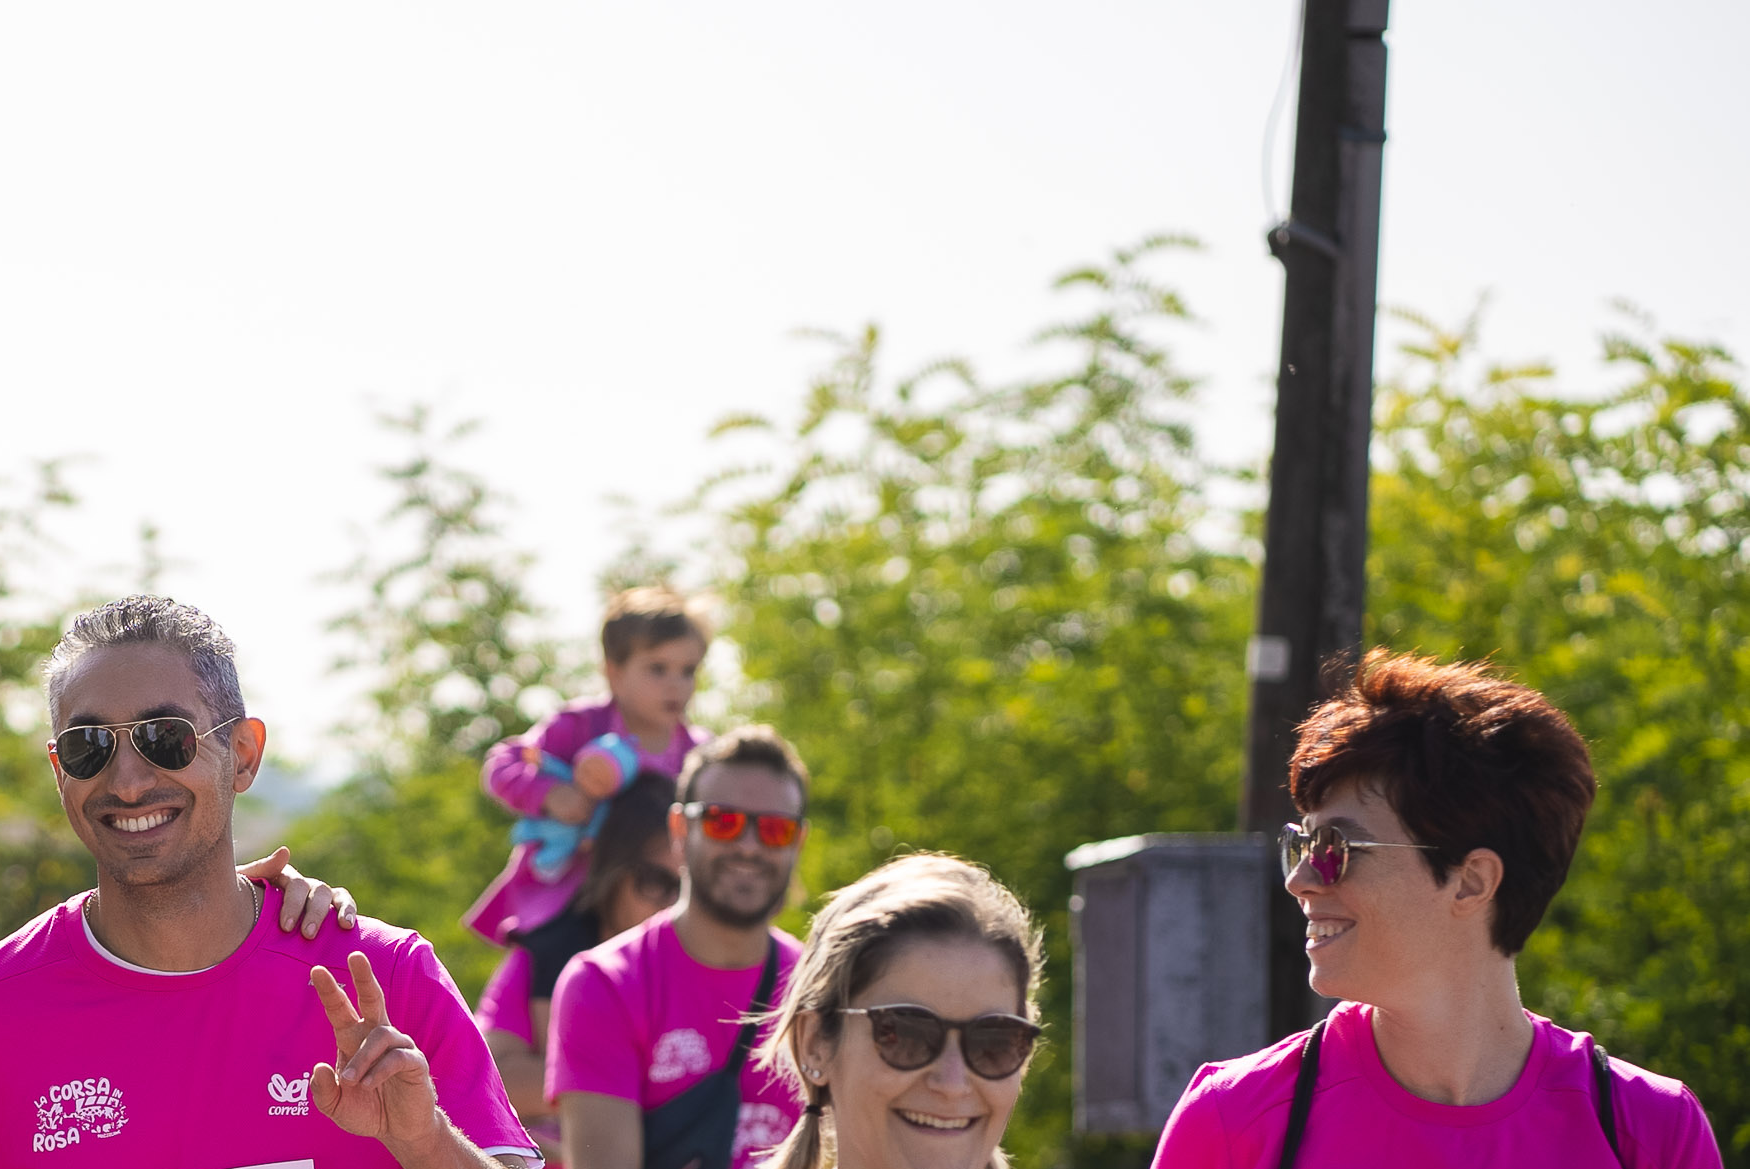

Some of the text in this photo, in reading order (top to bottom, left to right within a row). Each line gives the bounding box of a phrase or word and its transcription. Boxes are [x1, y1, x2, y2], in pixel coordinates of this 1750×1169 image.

[33, 1077, 124, 1109] LA CORSA IN
[267, 1071, 310, 1103] Sei
[268, 1105, 310, 1116] correre
[33, 1127, 80, 1152] ROSA
